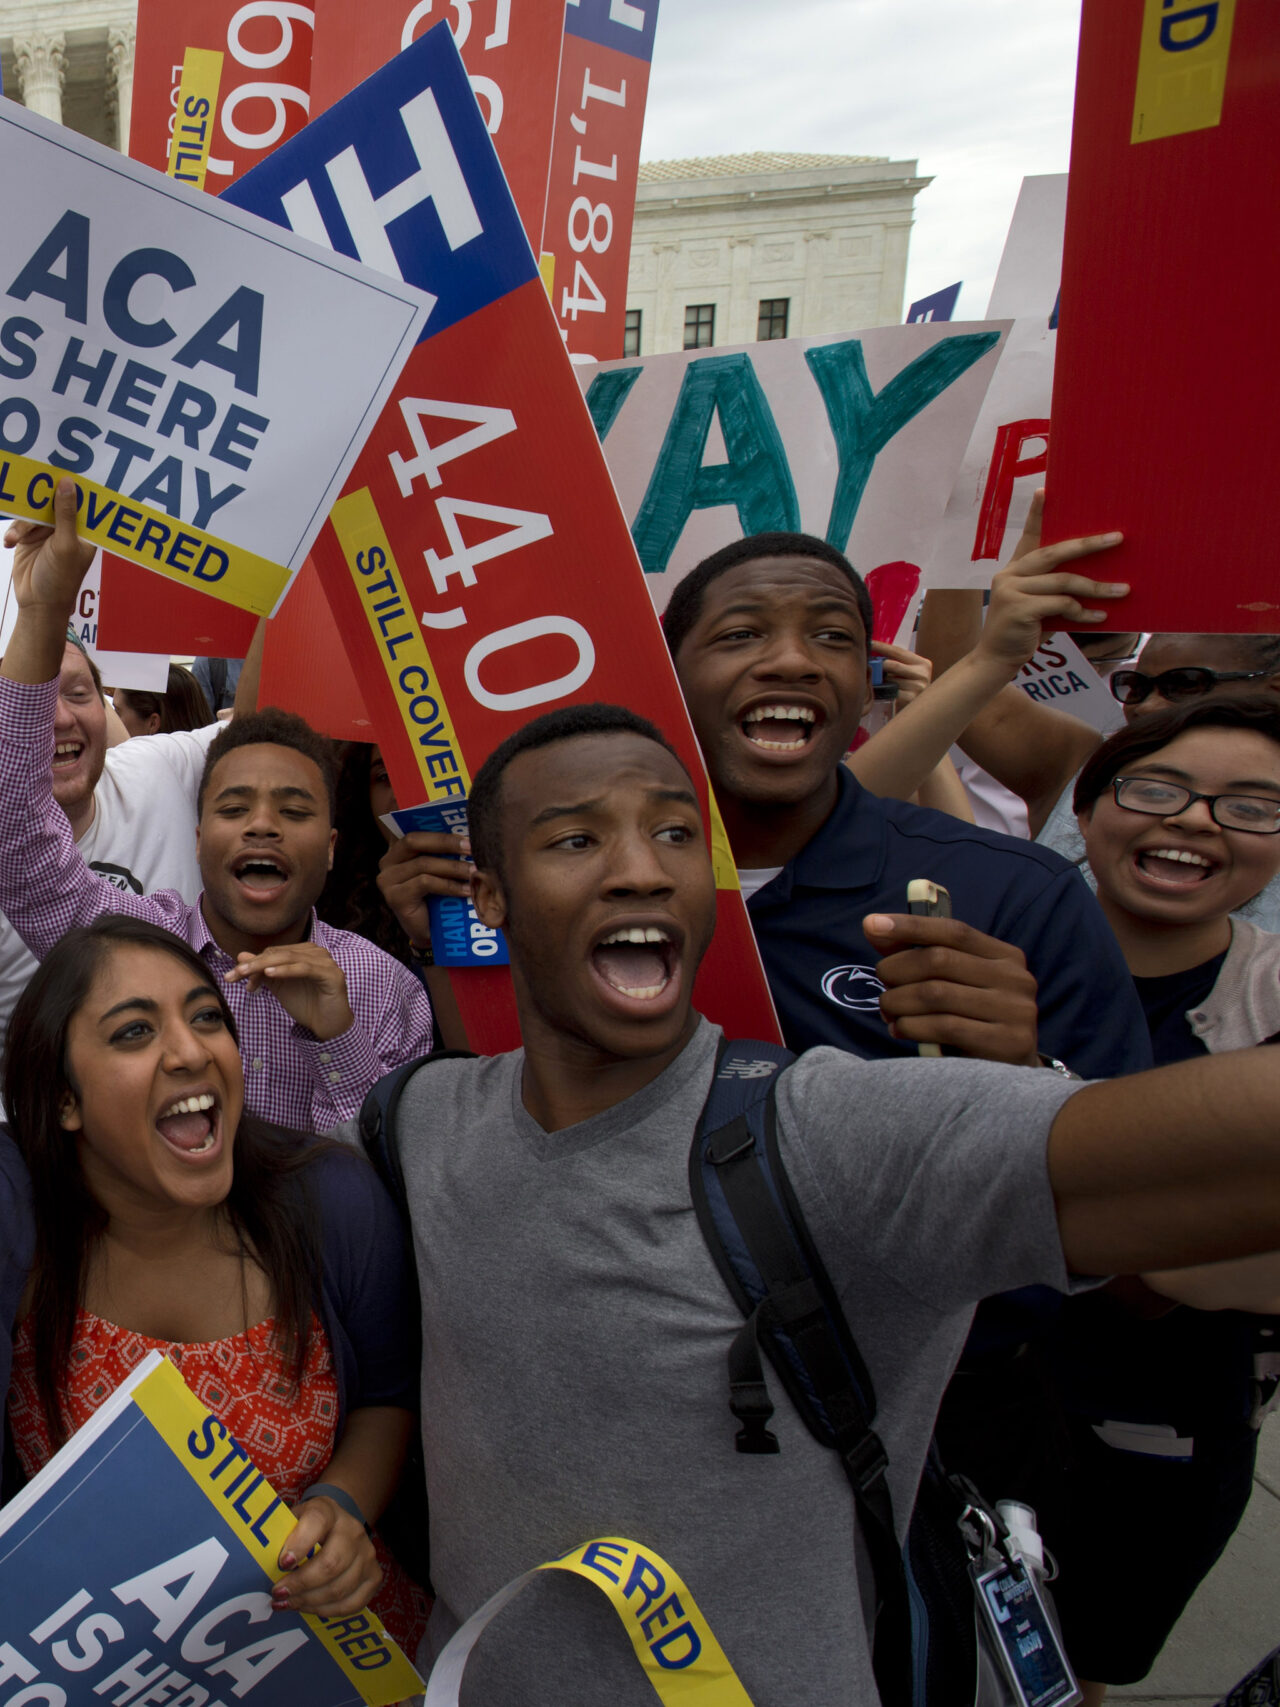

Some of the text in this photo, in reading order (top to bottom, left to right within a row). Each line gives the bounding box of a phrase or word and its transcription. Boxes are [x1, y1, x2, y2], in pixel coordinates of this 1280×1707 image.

[1159, 0, 1220, 53] D
[558, 67, 627, 366] 1,184,
[6, 209, 265, 398] ACA
[51, 336, 271, 472] HERE
[584, 331, 1002, 573] AY
[47, 415, 247, 531] STAY
[355, 545, 415, 661] STILL
[186, 1413, 270, 1548] STILL
[29, 1588, 125, 1673] IS
[110, 1536, 310, 1699] ACA
[550, 1541, 702, 1670] ERED
